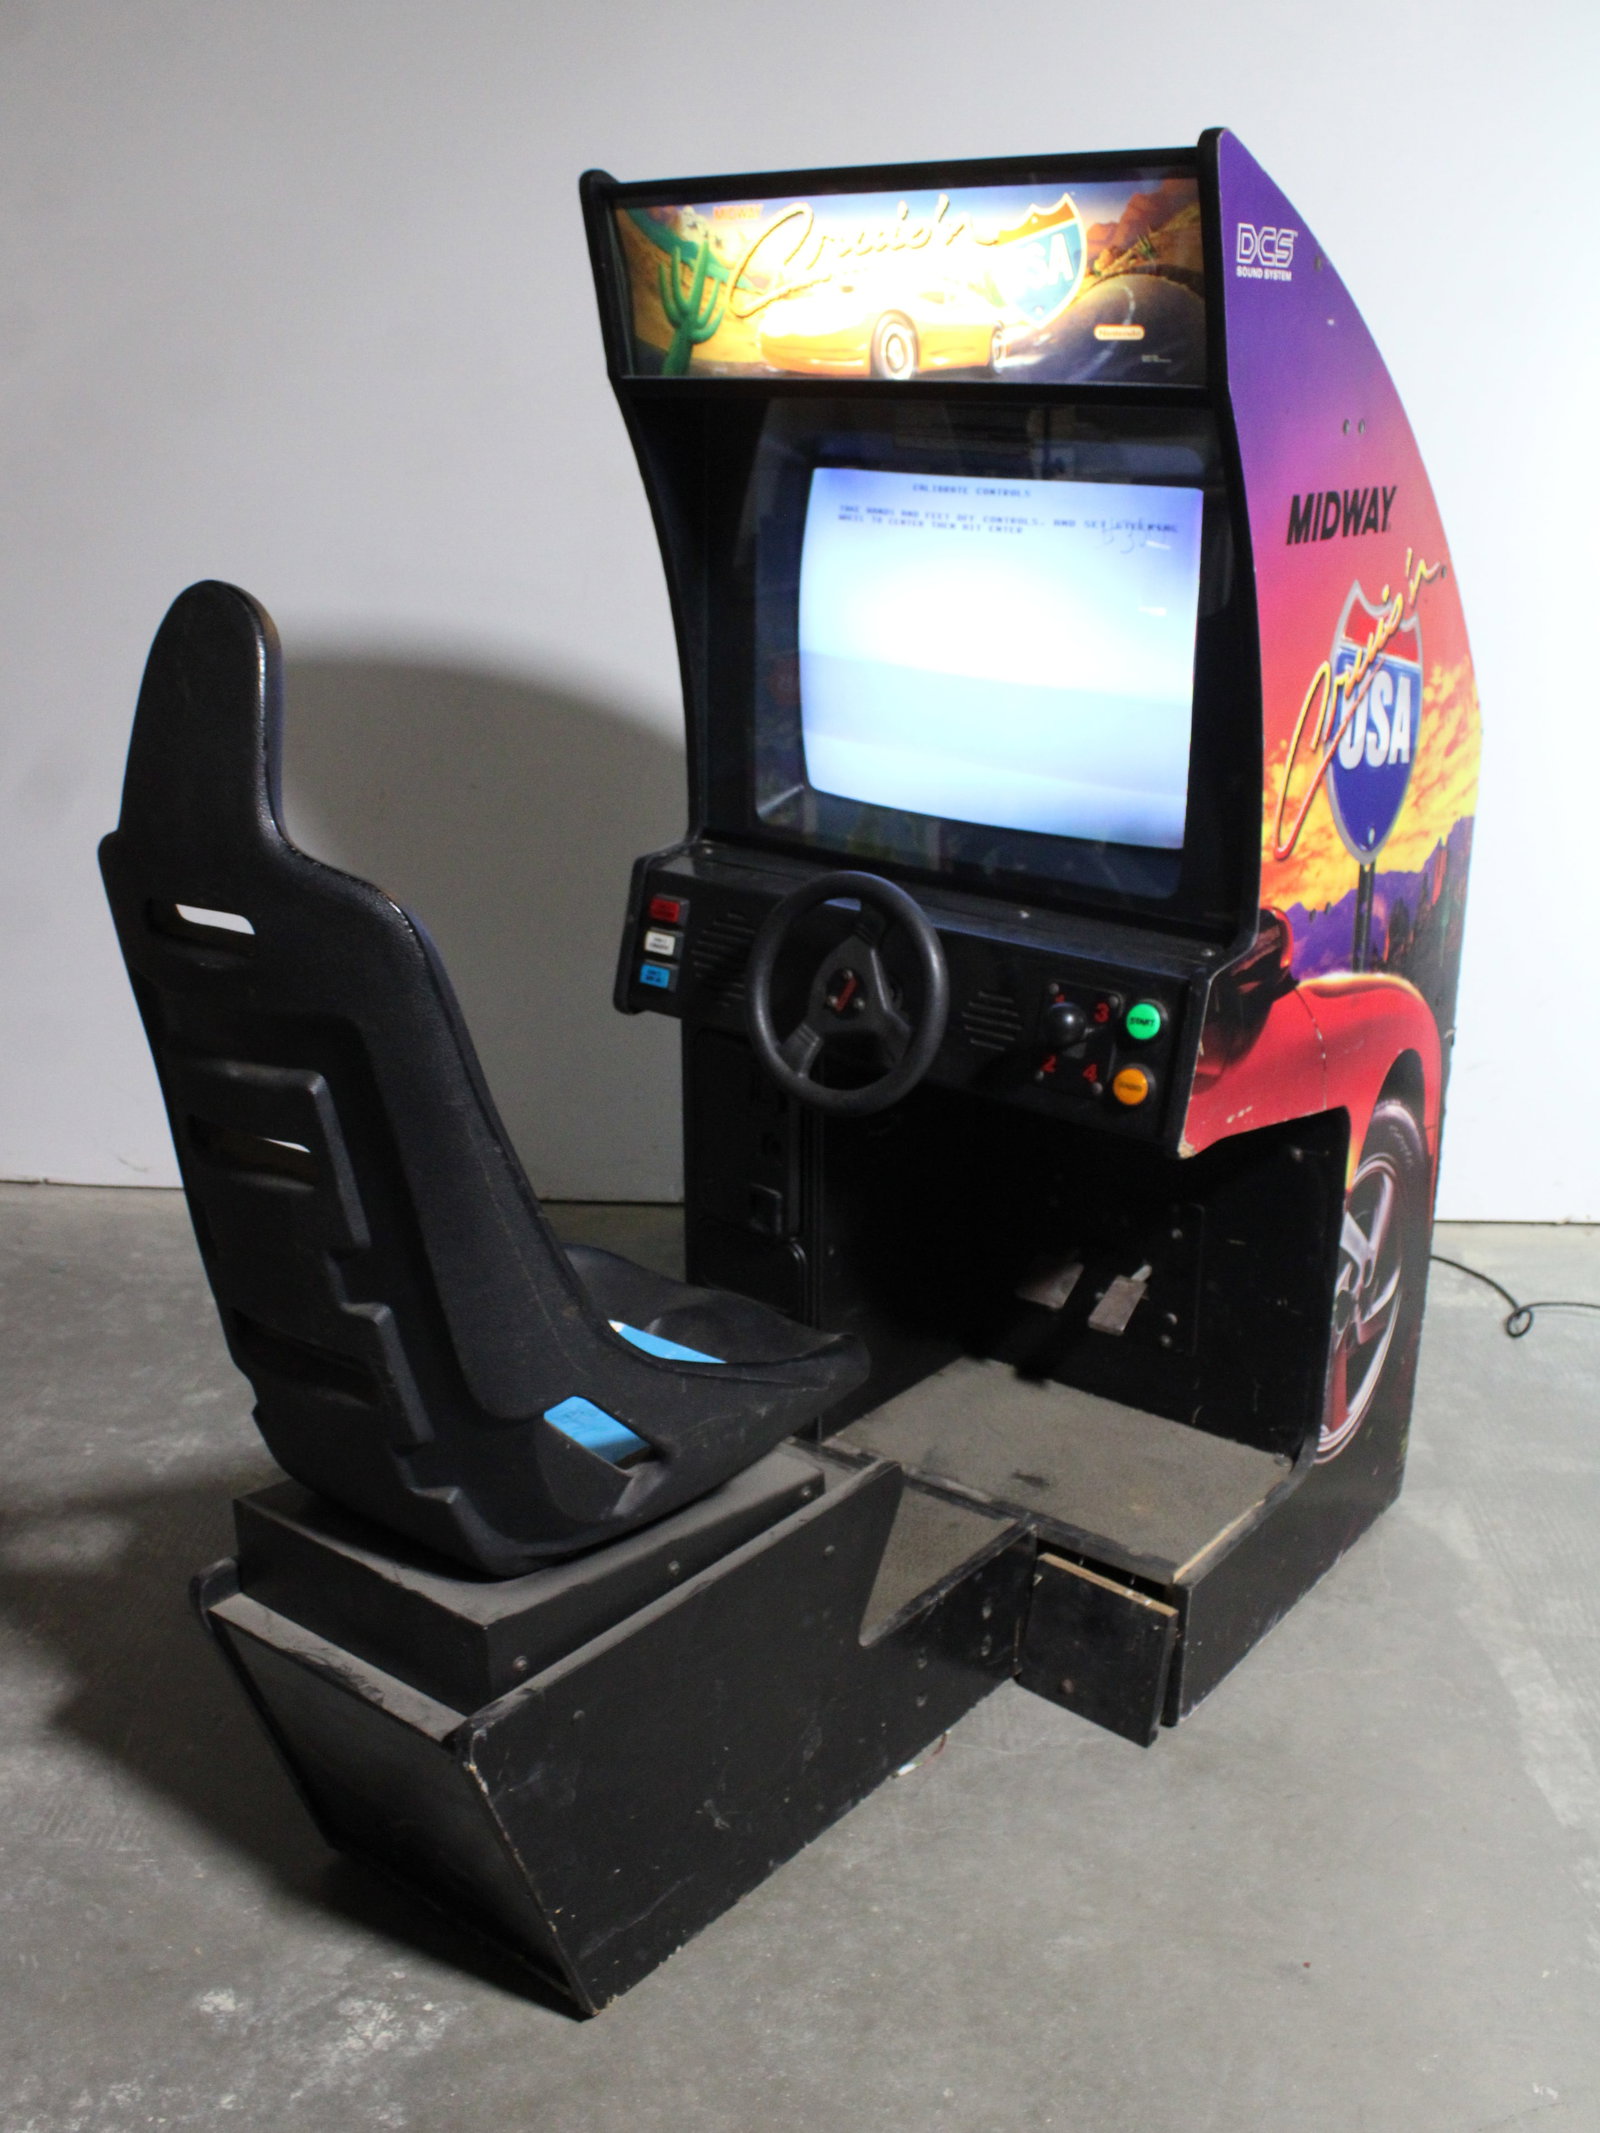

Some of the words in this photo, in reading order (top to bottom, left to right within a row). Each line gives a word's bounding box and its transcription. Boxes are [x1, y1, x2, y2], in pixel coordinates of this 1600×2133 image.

[1236, 222, 1298, 268] DCS
[1236, 265, 1263, 280] SOUND
[1264, 267, 1292, 282] SYSTEM
[975, 486, 1031, 498] CONTROLS
[1286, 486, 1397, 545] MIDWAY
[1338, 663, 1412, 770] USA
[1129, 1017, 1155, 1027] START
